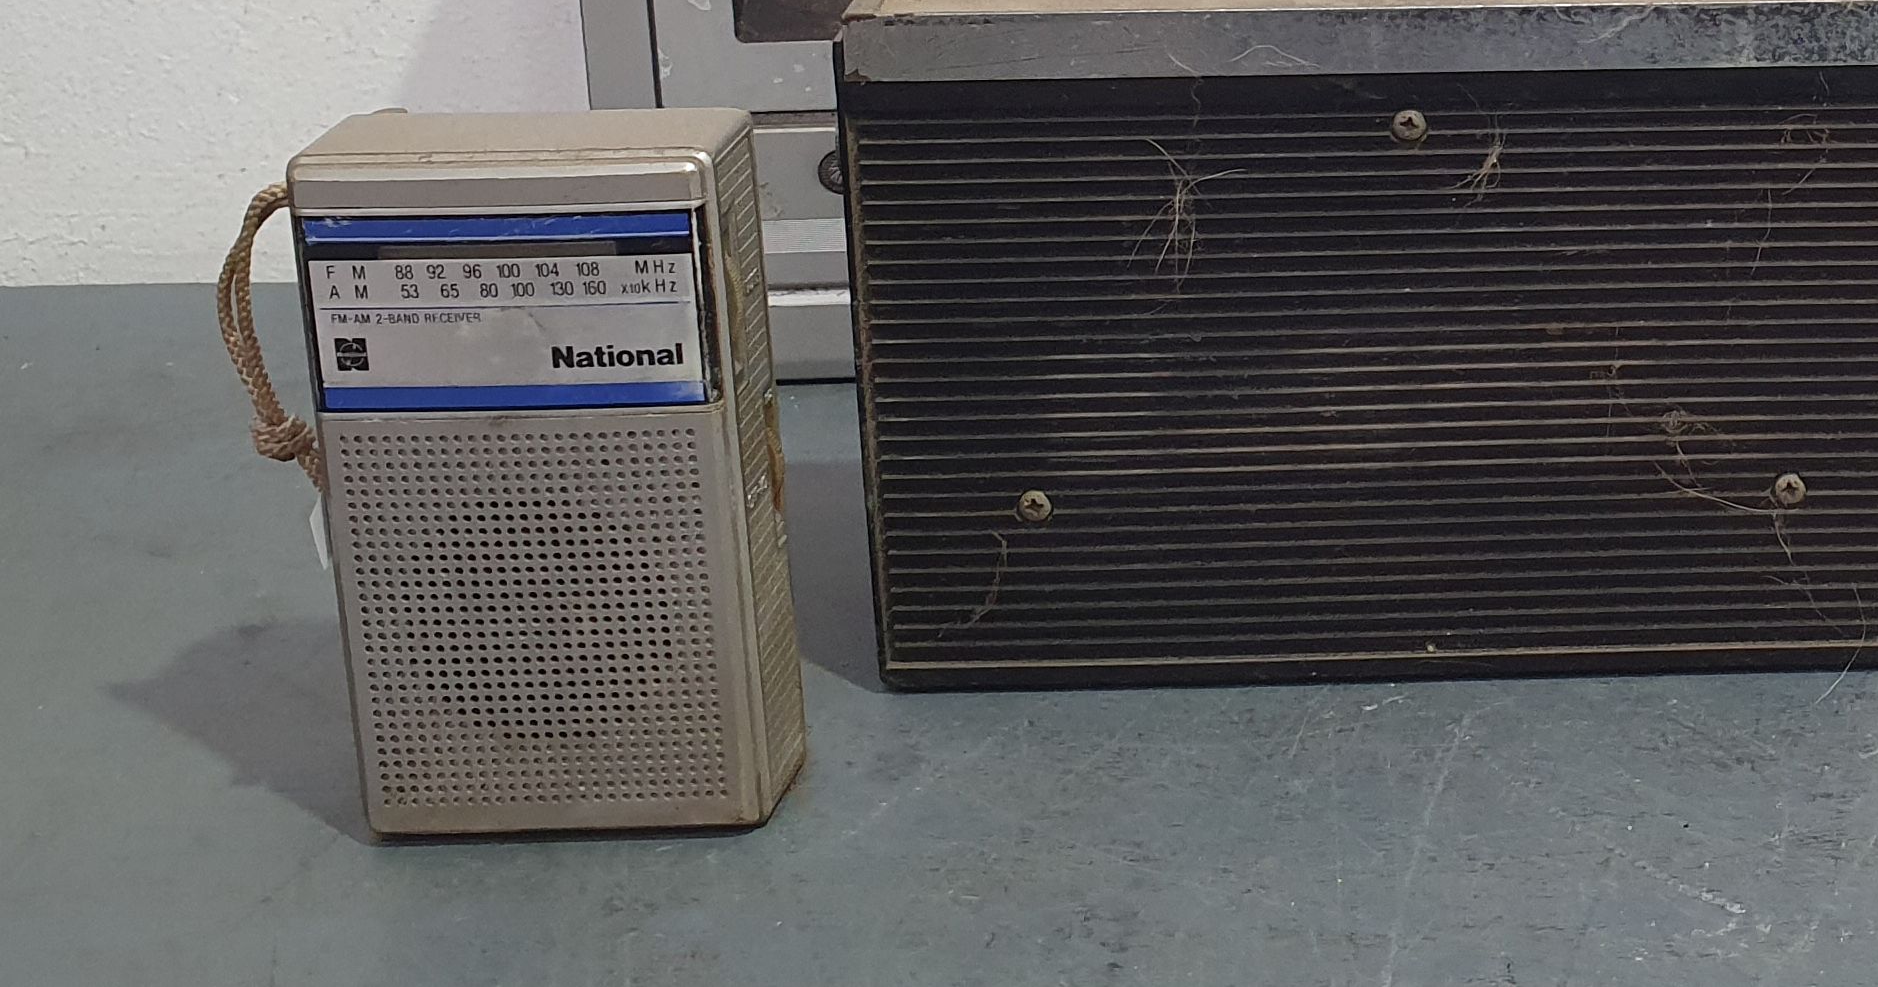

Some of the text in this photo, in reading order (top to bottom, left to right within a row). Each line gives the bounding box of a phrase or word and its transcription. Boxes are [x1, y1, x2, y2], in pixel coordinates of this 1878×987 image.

[394, 264, 414, 280] 88
[426, 263, 447, 279] 92
[462, 263, 482, 279] 96
[496, 263, 521, 279] 100
[535, 262, 560, 278] 104
[576, 261, 600, 277] 108
[400, 283, 420, 300] 53
[440, 282, 460, 299] 65
[479, 282, 499, 298] 80
[511, 281, 536, 298] 100
[549, 280, 575, 297] 130
[582, 280, 607, 296] 160
[330, 311, 481, 325] FM-AM 2-BAND RECEIVER
[551, 342, 684, 370] National
